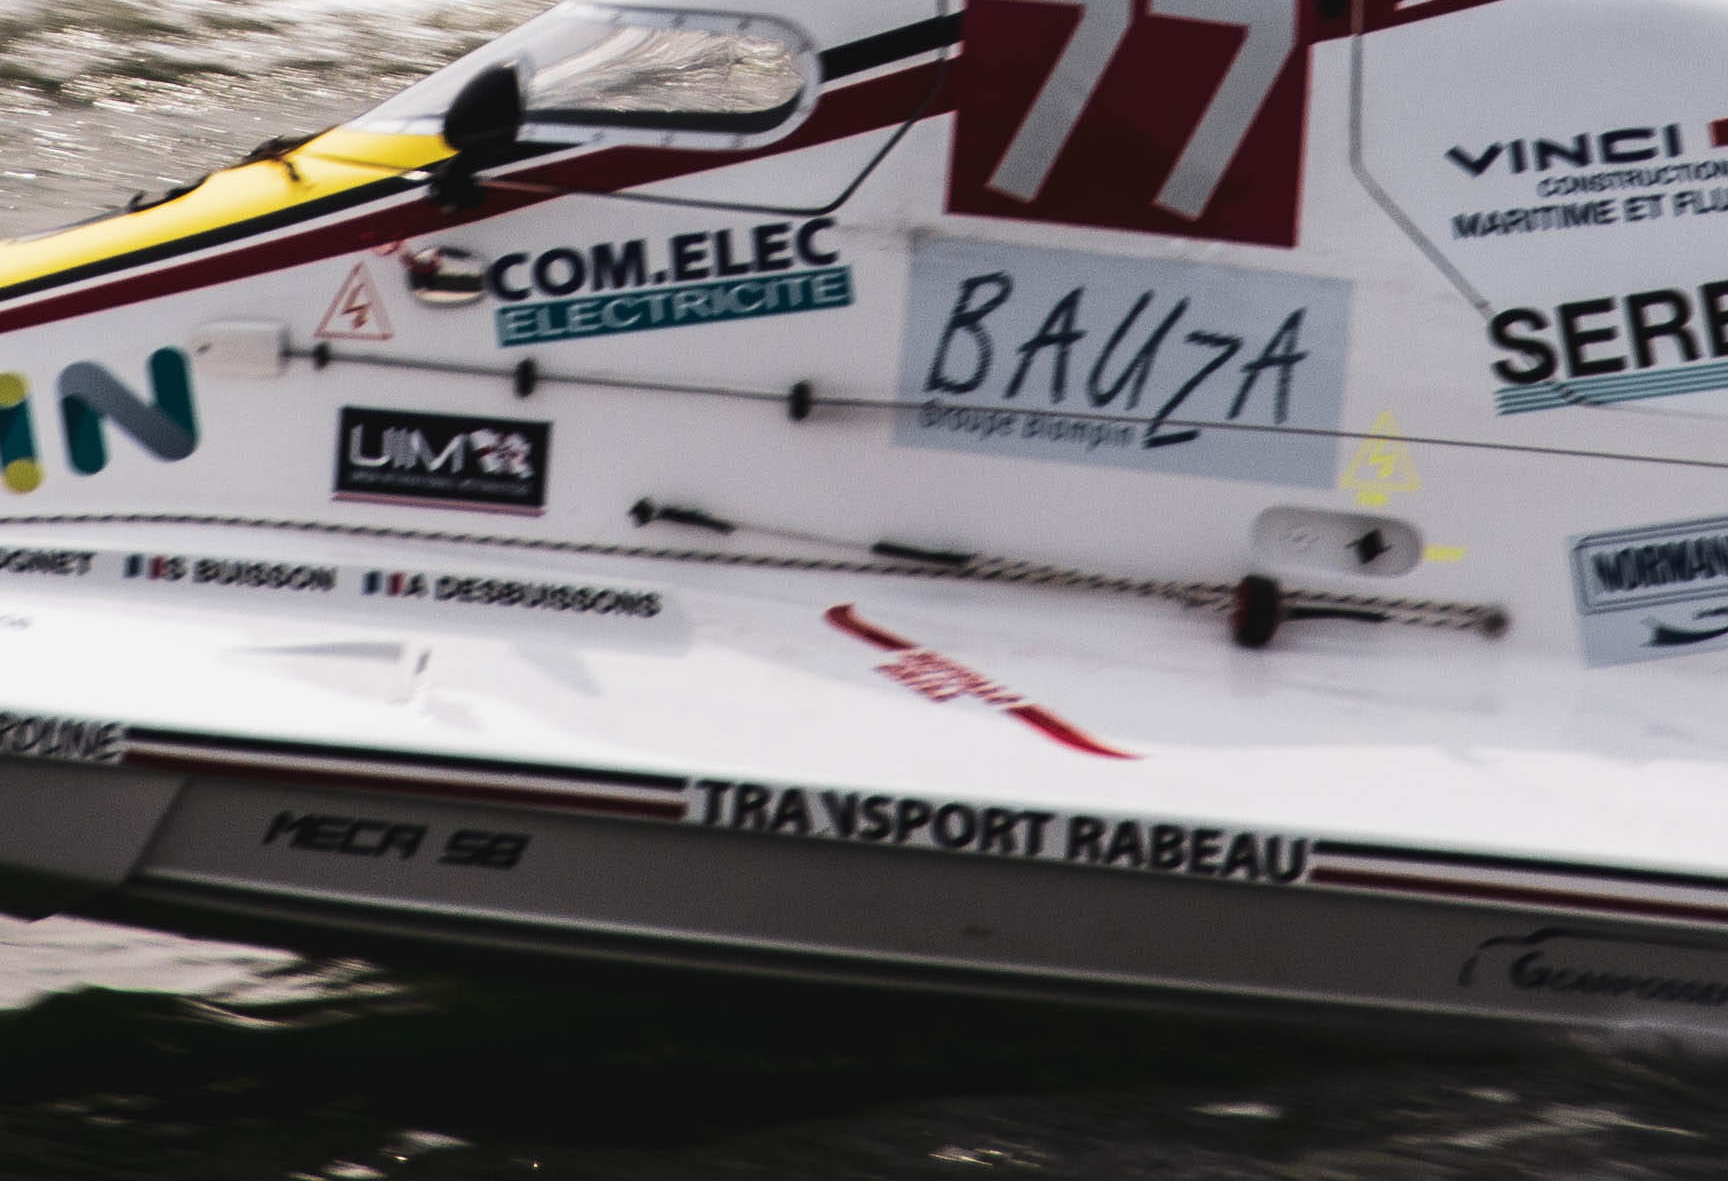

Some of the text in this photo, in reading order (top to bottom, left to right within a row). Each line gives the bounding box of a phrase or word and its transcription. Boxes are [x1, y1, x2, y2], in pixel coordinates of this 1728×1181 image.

[1445, 123, 1684, 178] VINCI
[1452, 198, 1611, 240] MARITIME
[1620, 191, 1666, 224] ET
[484, 218, 841, 301] COM.ELEC
[504, 273, 850, 342] ELECTRICITE
[924, 272, 1309, 449] BAUZA
[193, 557, 338, 593] BUISSON
[696, 778, 1313, 885] TRANSPORT RABEAU
